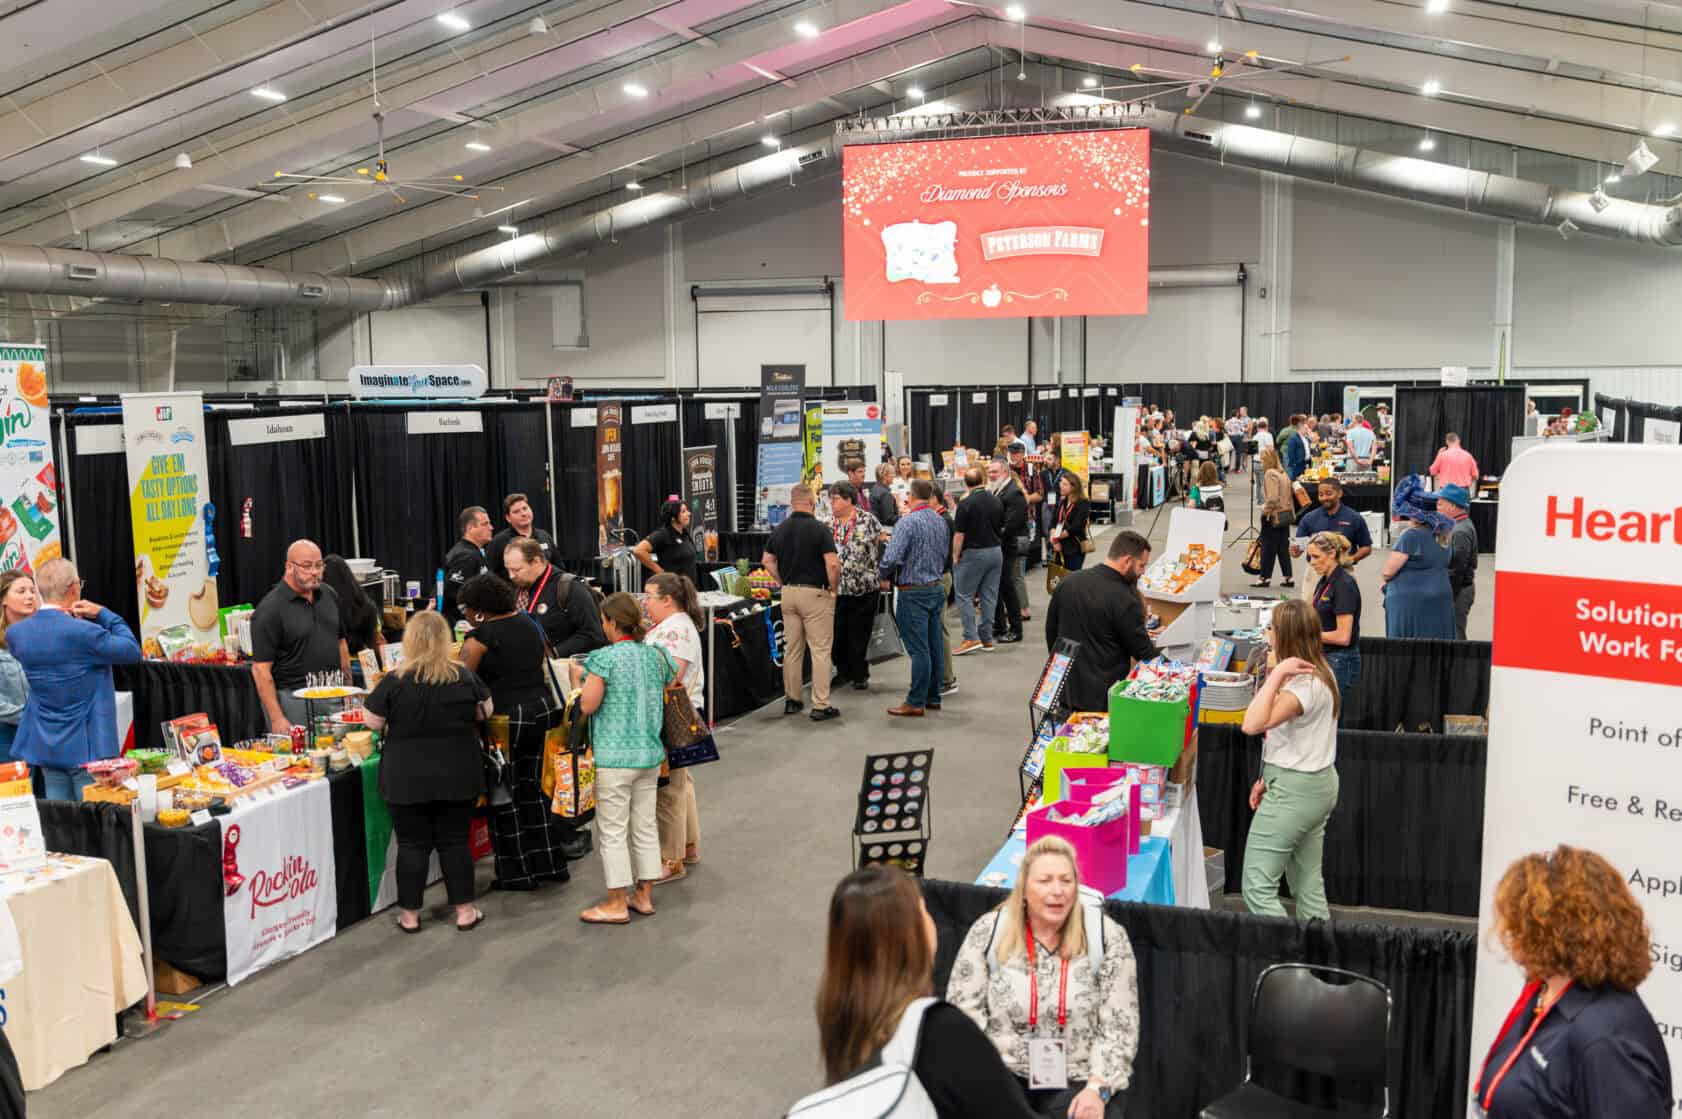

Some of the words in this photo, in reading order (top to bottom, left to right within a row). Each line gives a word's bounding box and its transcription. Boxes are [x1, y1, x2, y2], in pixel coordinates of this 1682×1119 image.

[920, 181, 994, 203] Diamond
[996, 180, 1068, 204] Sponsors
[986, 232, 1053, 254] PETERSON
[1054, 230, 1099, 250] FARMS
[152, 454, 169, 475] GIVE
[141, 478, 165, 499] TASTY
[166, 473, 198, 495] OPTIONS
[146, 502, 161, 522] ALL
[161, 499, 176, 520] DAY
[176, 497, 197, 517] LONG
[1576, 598, 1682, 628] Solution
[1579, 631, 1650, 659] Work
[1590, 717, 1648, 744] Point
[1568, 785, 1618, 811] Free
[1627, 795, 1644, 817] &
[1655, 800, 1682, 822] Re
